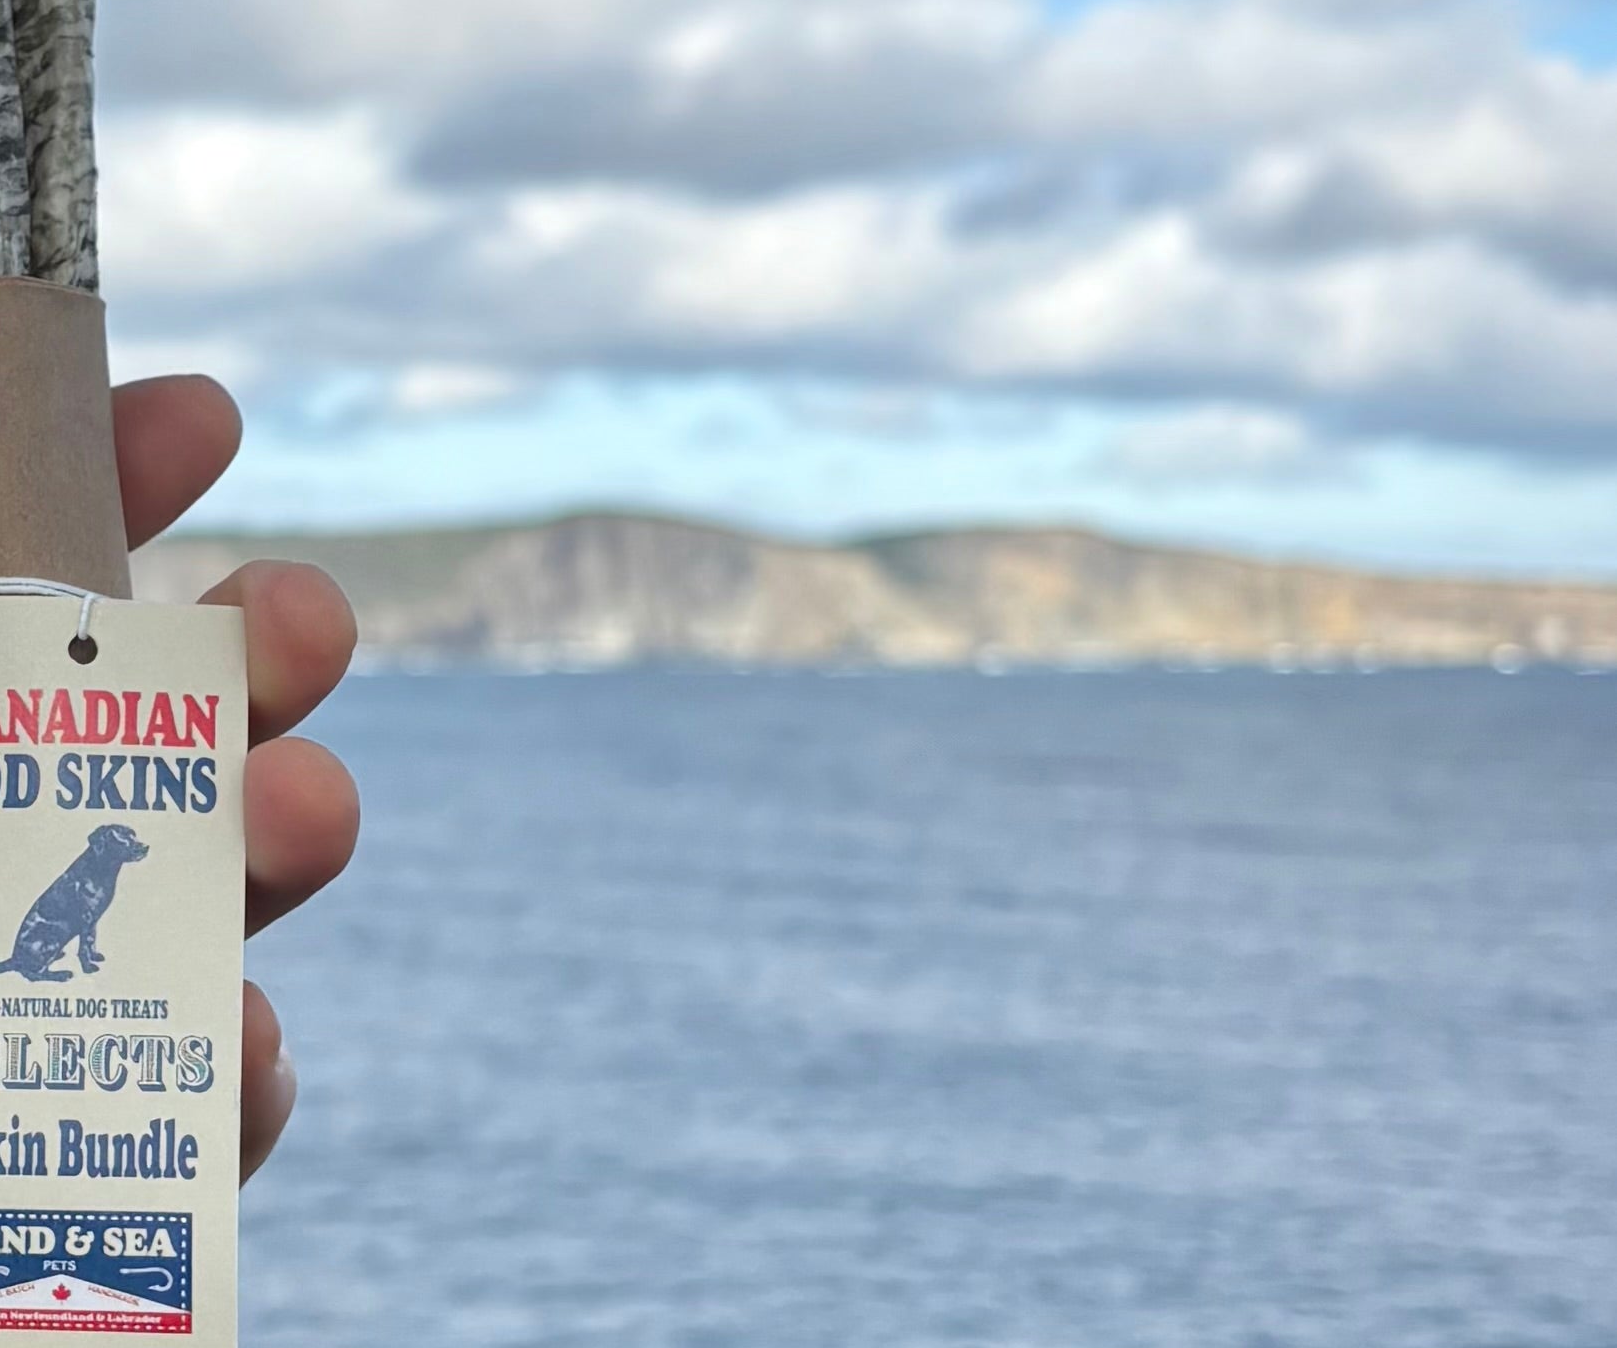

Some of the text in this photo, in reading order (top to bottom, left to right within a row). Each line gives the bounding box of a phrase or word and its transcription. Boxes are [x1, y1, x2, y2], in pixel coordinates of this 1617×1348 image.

[55, 752, 218, 814] SKINS
[75, 998, 108, 1019] DOG
[110, 999, 169, 1020] TREATS
[57, 1117, 199, 1180] Bundle
[64, 1225, 95, 1256] &
[103, 1227, 178, 1258] SEA
[42, 1259, 77, 1272] PETS
